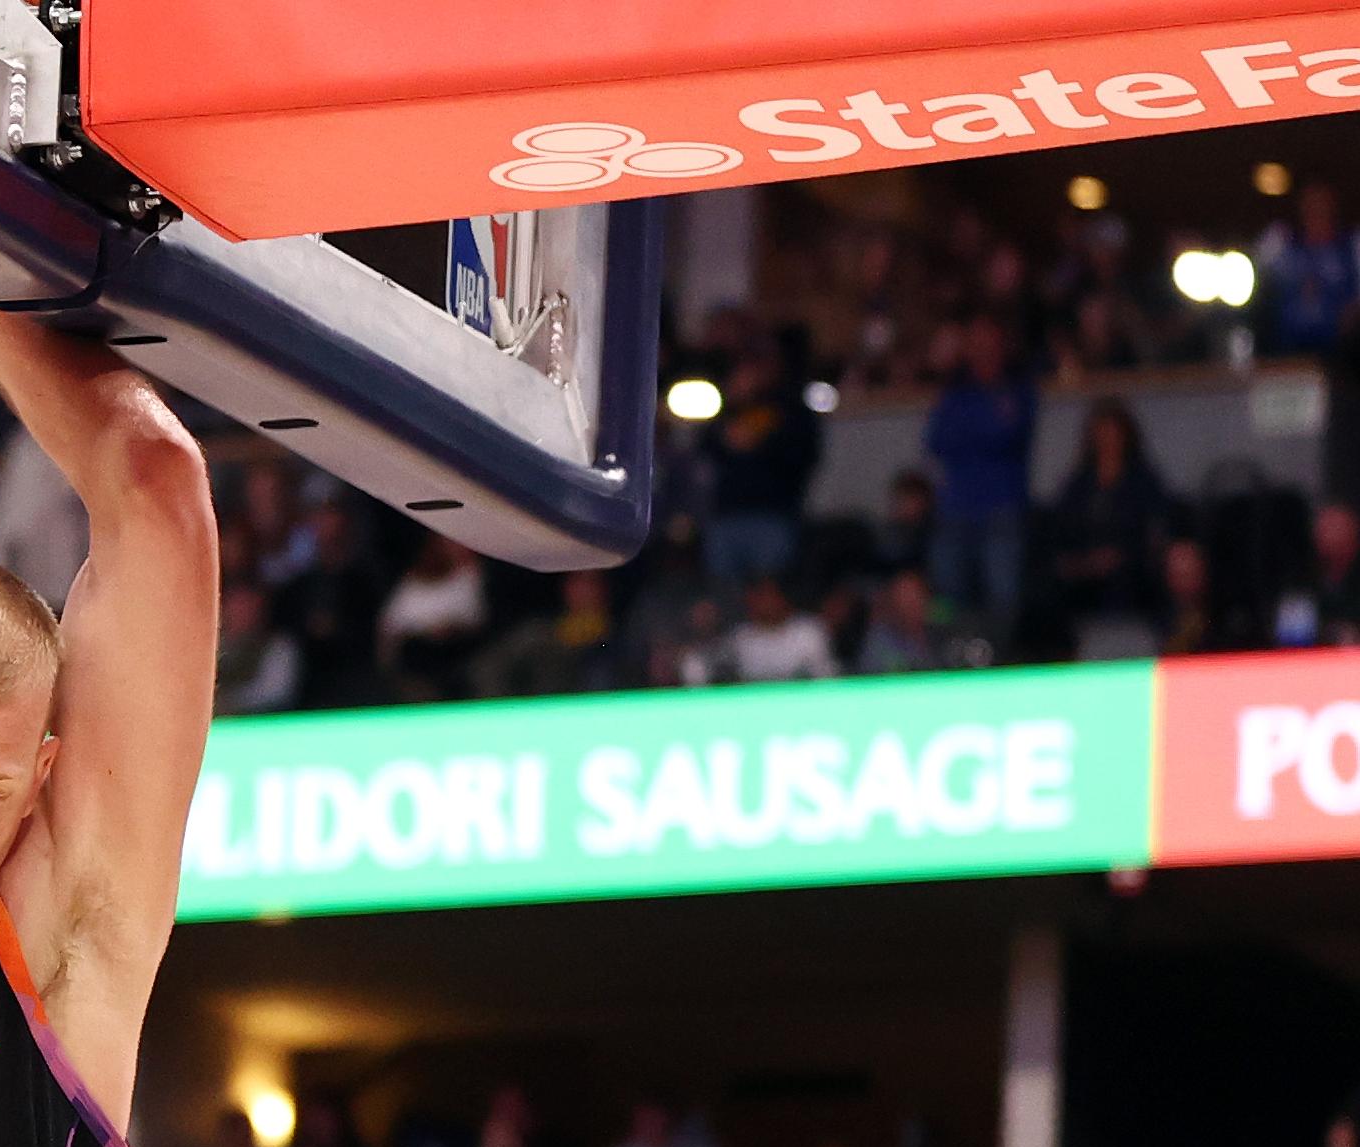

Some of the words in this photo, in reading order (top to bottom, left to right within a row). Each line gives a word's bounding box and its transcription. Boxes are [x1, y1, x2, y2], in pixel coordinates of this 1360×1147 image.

[738, 68, 1206, 165] State
[455, 262, 485, 324] NBA
[180, 752, 548, 876] LIDORI
[577, 718, 1075, 857] SAUSAGE
